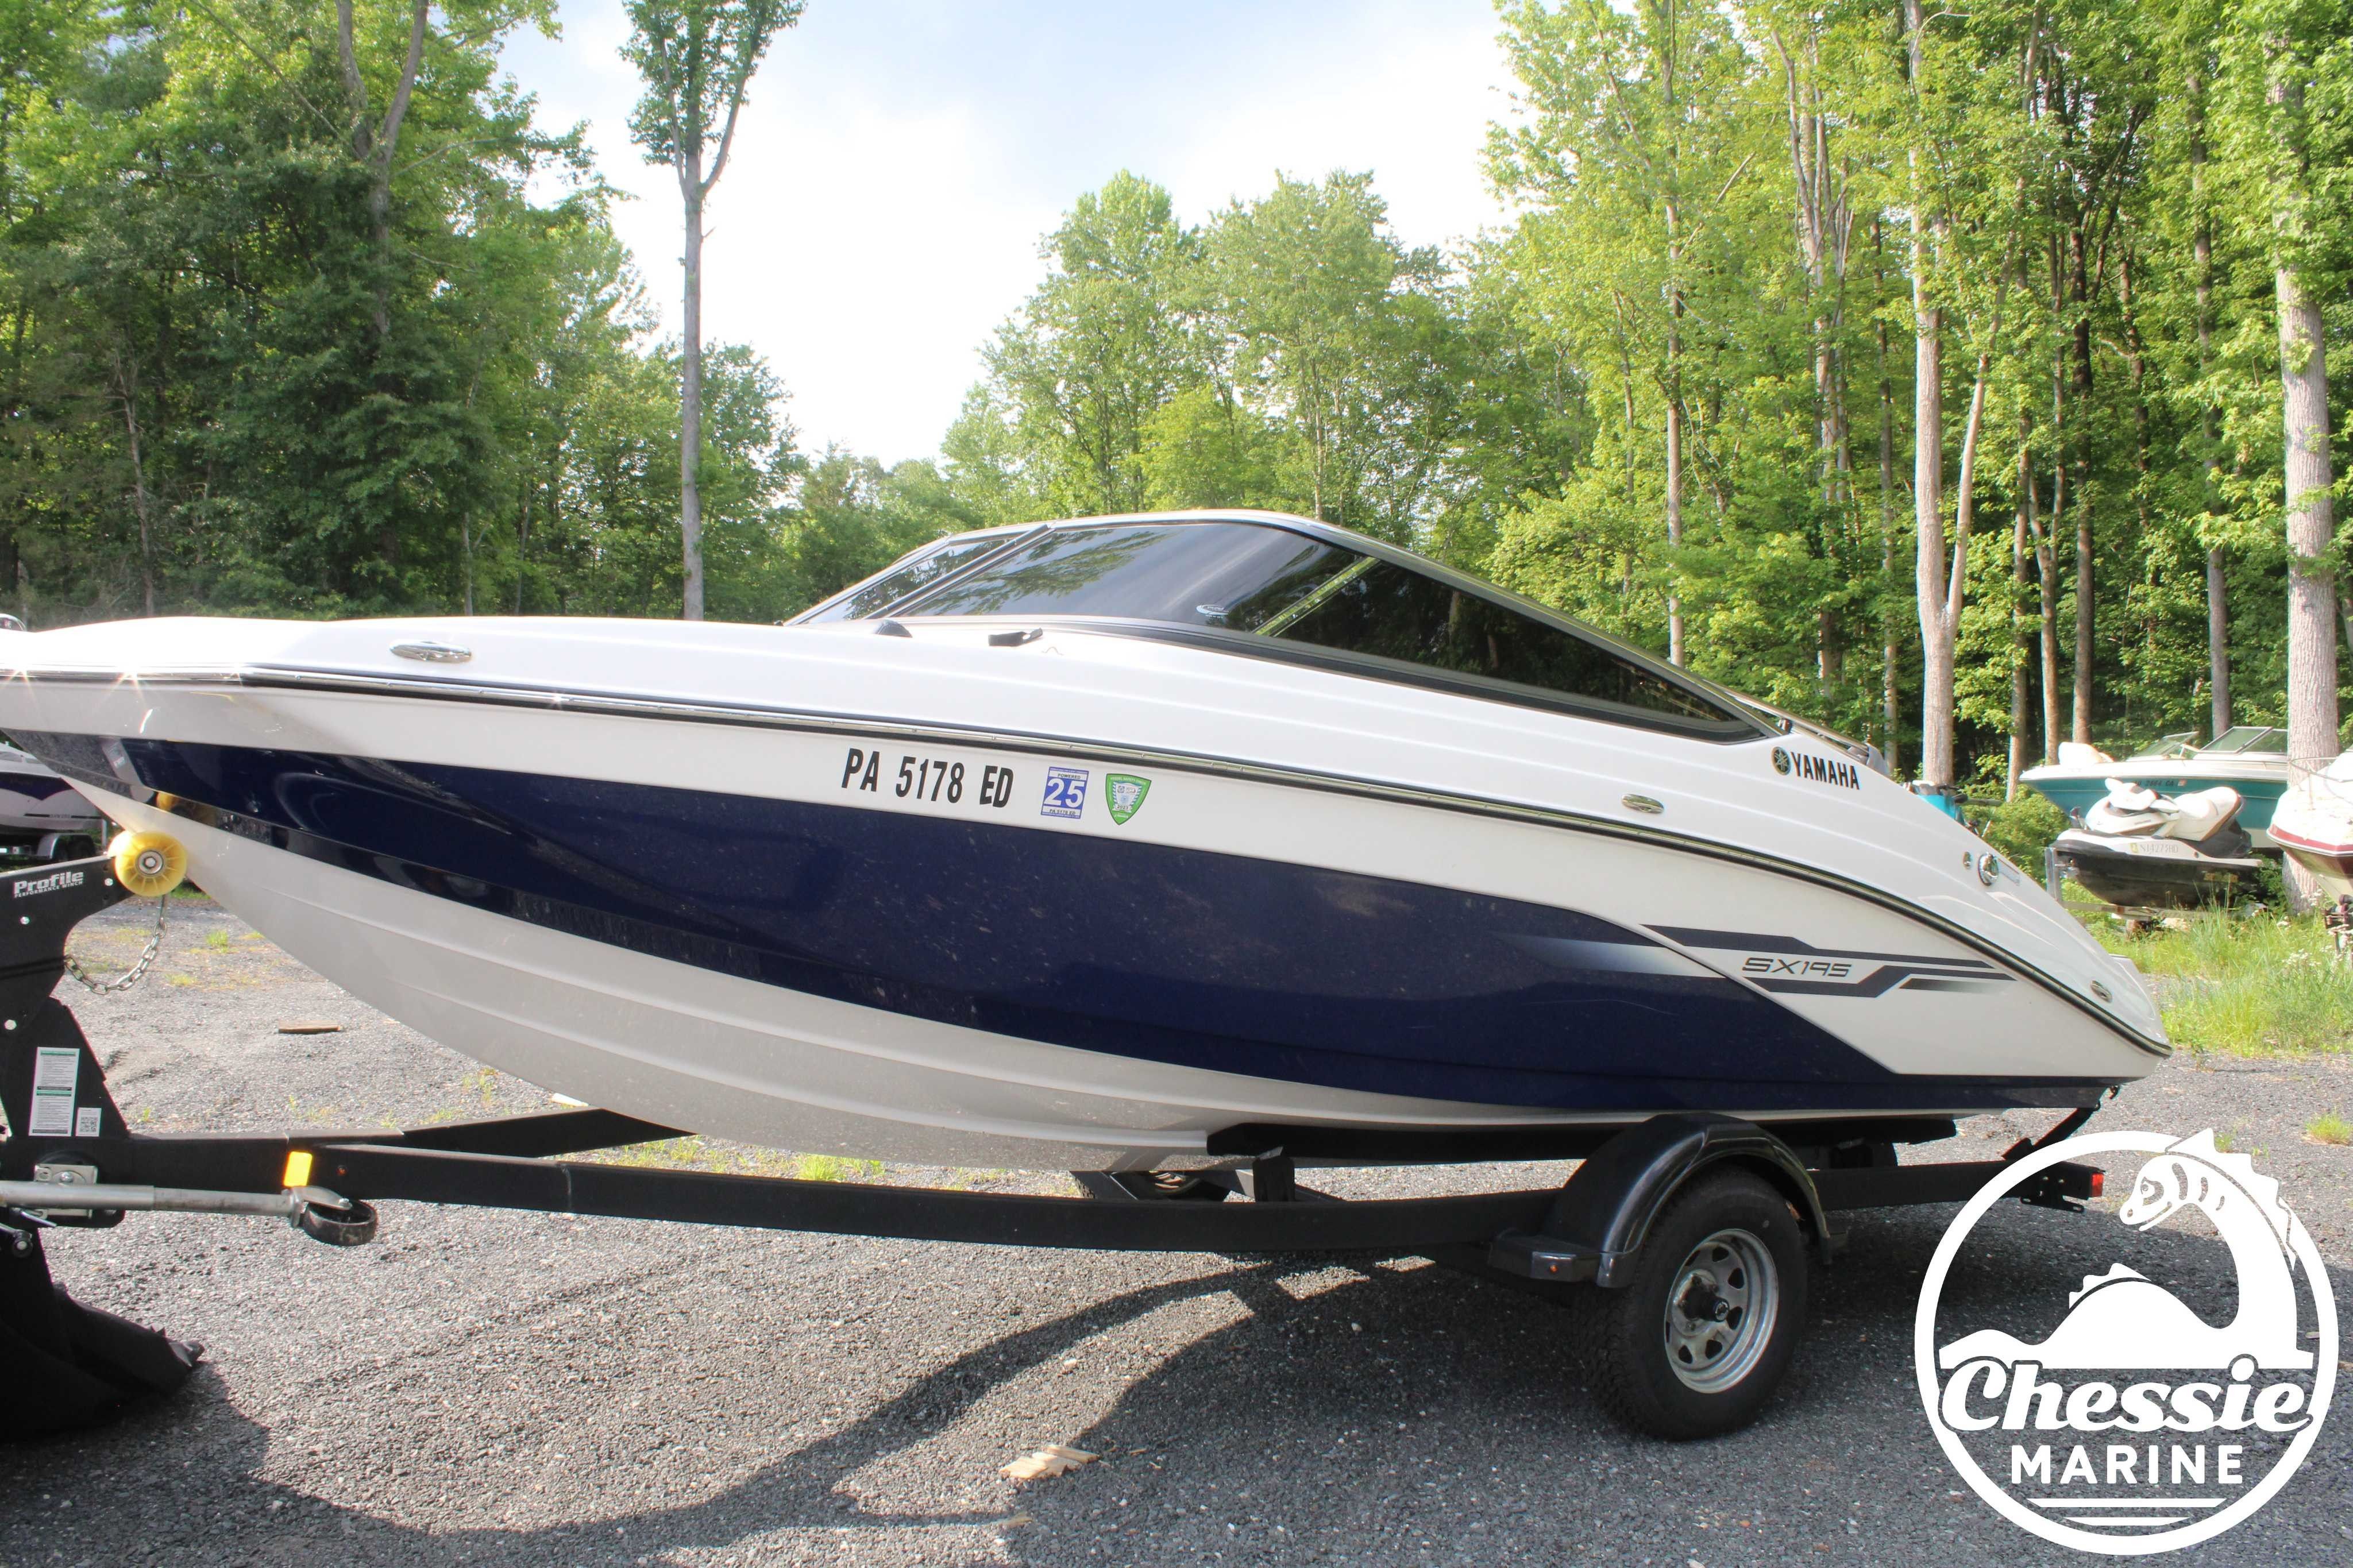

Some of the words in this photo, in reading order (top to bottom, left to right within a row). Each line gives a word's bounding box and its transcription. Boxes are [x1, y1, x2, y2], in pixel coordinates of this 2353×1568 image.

[841, 748, 880, 792] PA
[895, 756, 965, 804] 5178
[979, 765, 1014, 808] ED
[1790, 751, 1860, 790] YAMAHA
[1043, 778, 1085, 808] 25
[14, 871, 84, 894] Profile
[14, 885, 60, 898] PERFORMANCE
[1742, 957, 1853, 978] SX195
